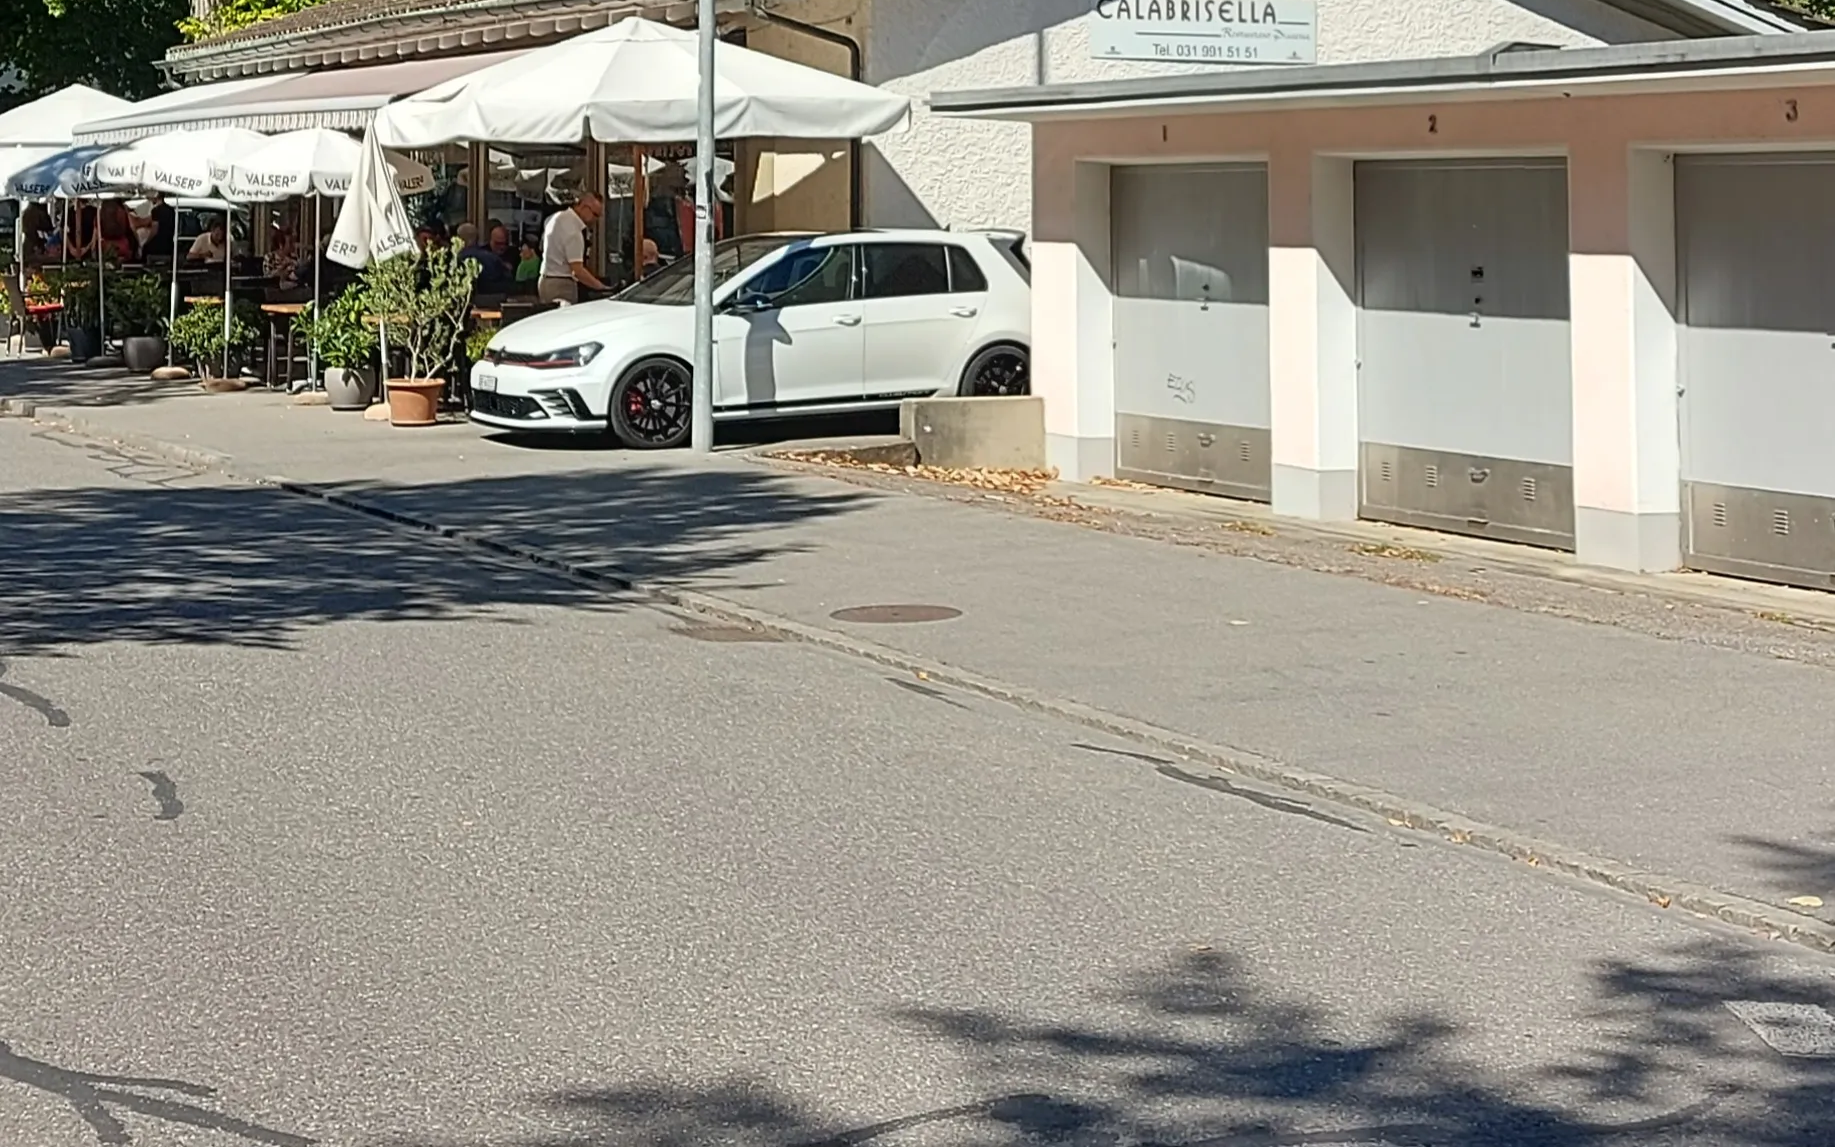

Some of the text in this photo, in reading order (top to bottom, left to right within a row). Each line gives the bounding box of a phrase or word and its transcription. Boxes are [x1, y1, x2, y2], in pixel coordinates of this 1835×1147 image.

[1152, 43, 1258, 58] Tel. 031 991 51 51
[1785, 99, 1798, 123] 3
[1428, 114, 1438, 134] 2
[245, 172, 290, 188] VALSER
